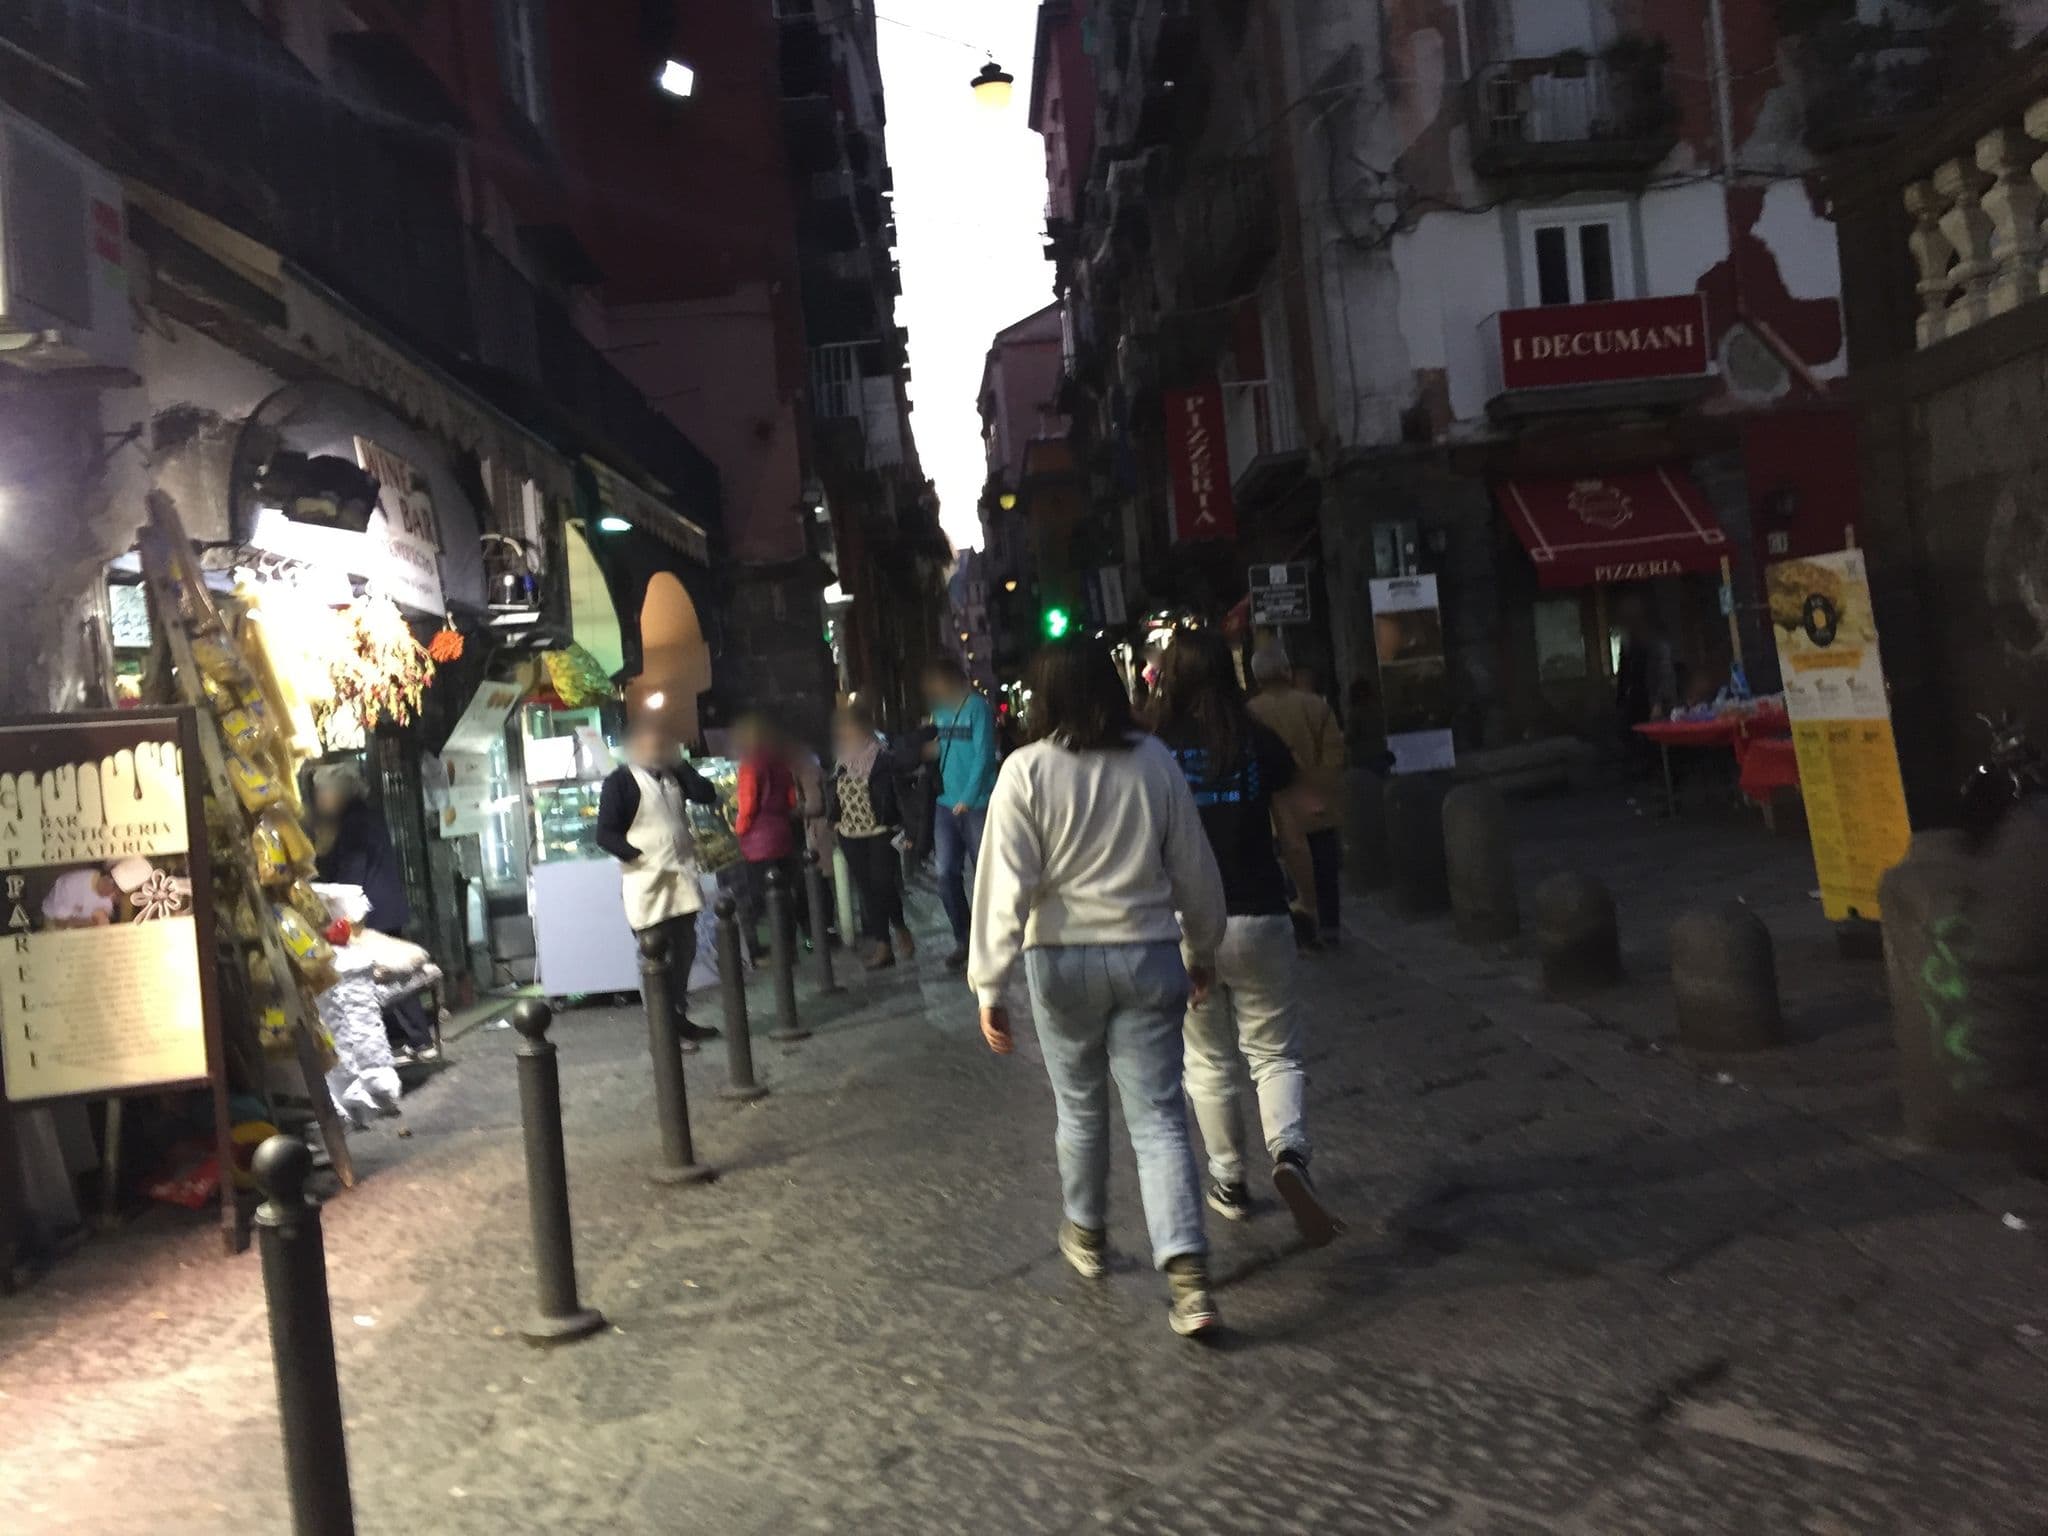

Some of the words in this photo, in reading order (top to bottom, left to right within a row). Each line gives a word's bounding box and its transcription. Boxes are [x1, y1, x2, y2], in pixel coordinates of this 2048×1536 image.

[1512, 337, 1523, 361] I
[1531, 323, 1694, 360] DECUMANI
[1185, 395, 1217, 526] PIZZERIA
[1594, 559, 1682, 582] PIZZERIA
[40, 815, 78, 829] BAR
[41, 822, 171, 845] PASTICCERIA
[41, 840, 155, 860] GELATERIA
